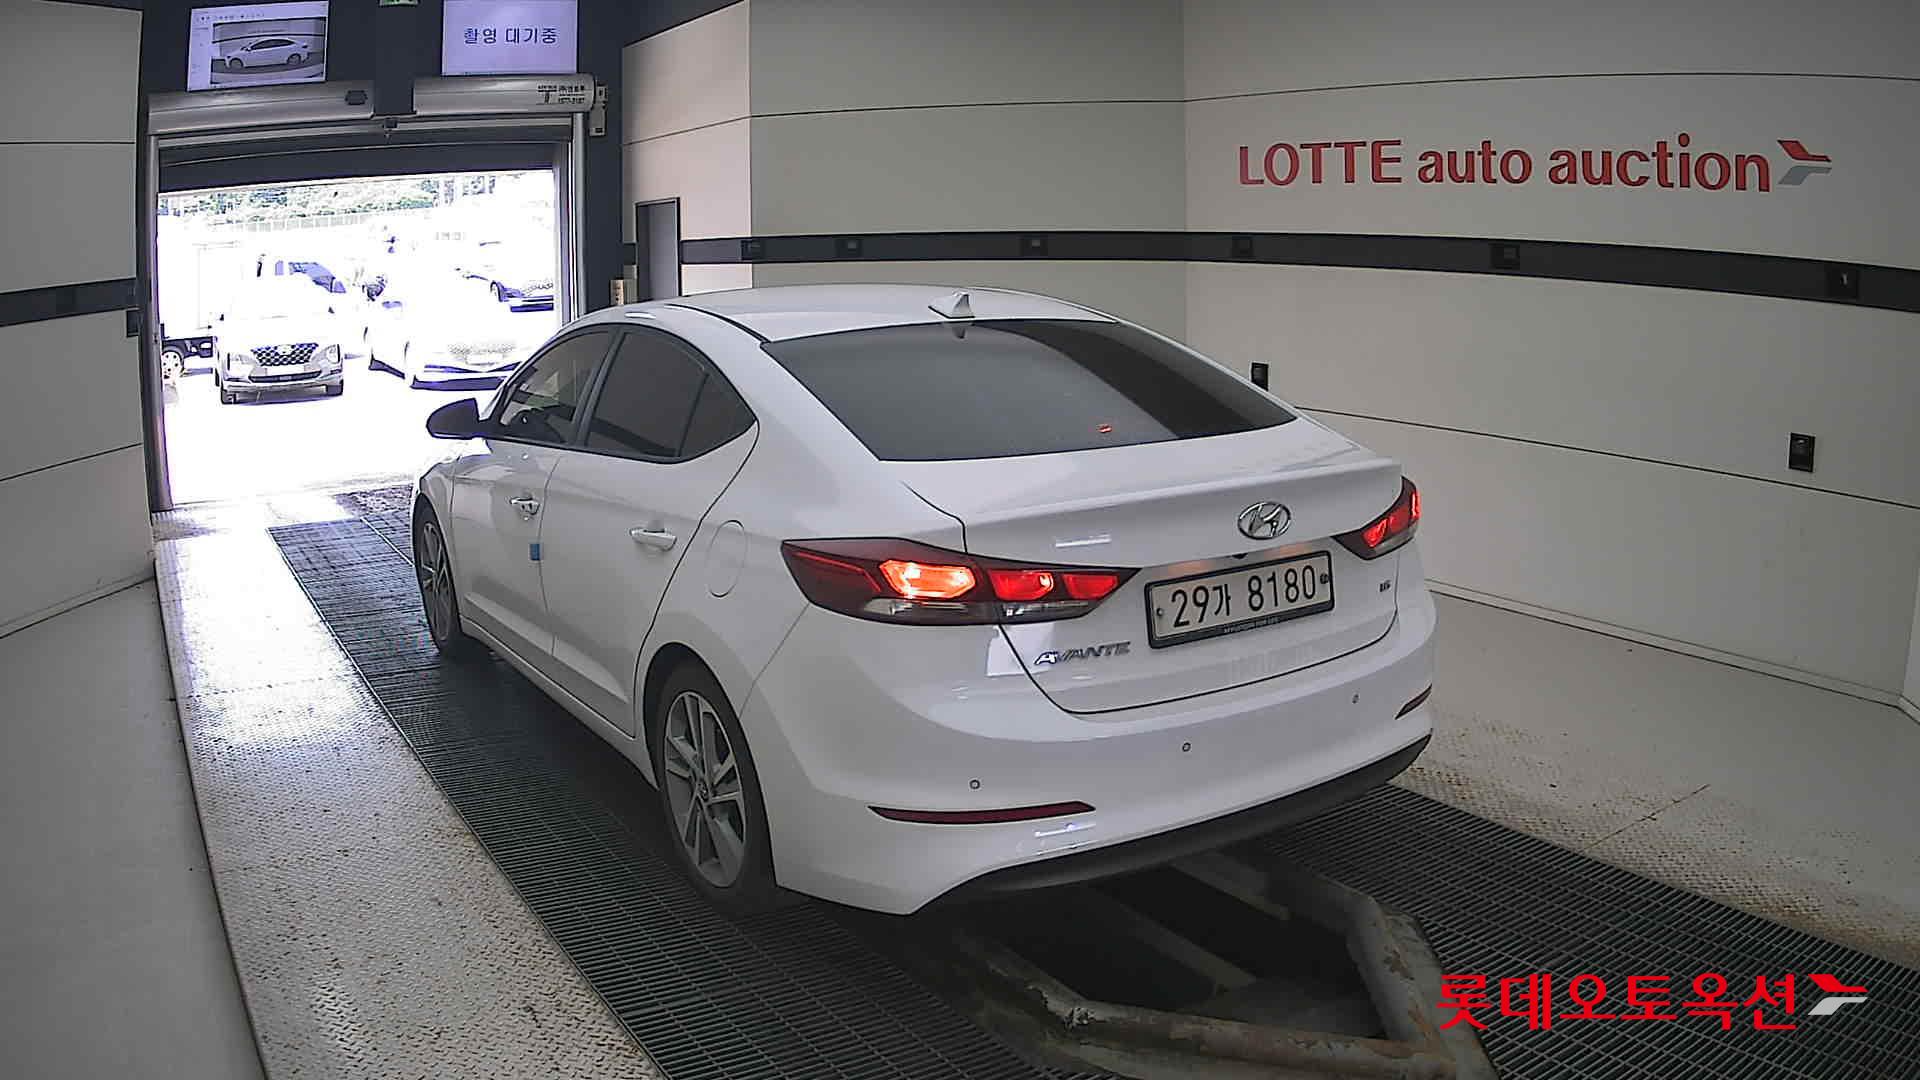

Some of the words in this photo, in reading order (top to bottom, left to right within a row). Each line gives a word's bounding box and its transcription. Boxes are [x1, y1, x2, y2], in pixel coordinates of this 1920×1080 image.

[464, 27, 497, 44] 촬영
[505, 27, 558, 44] 대기중
[1239, 140, 1402, 185] LOTTE
[1417, 140, 1532, 185] auto
[1548, 132, 1771, 193] auction
[1171, 584, 1231, 628] 29가
[1248, 565, 1316, 612] 8180
[1033, 641, 1131, 665] AVANTE
